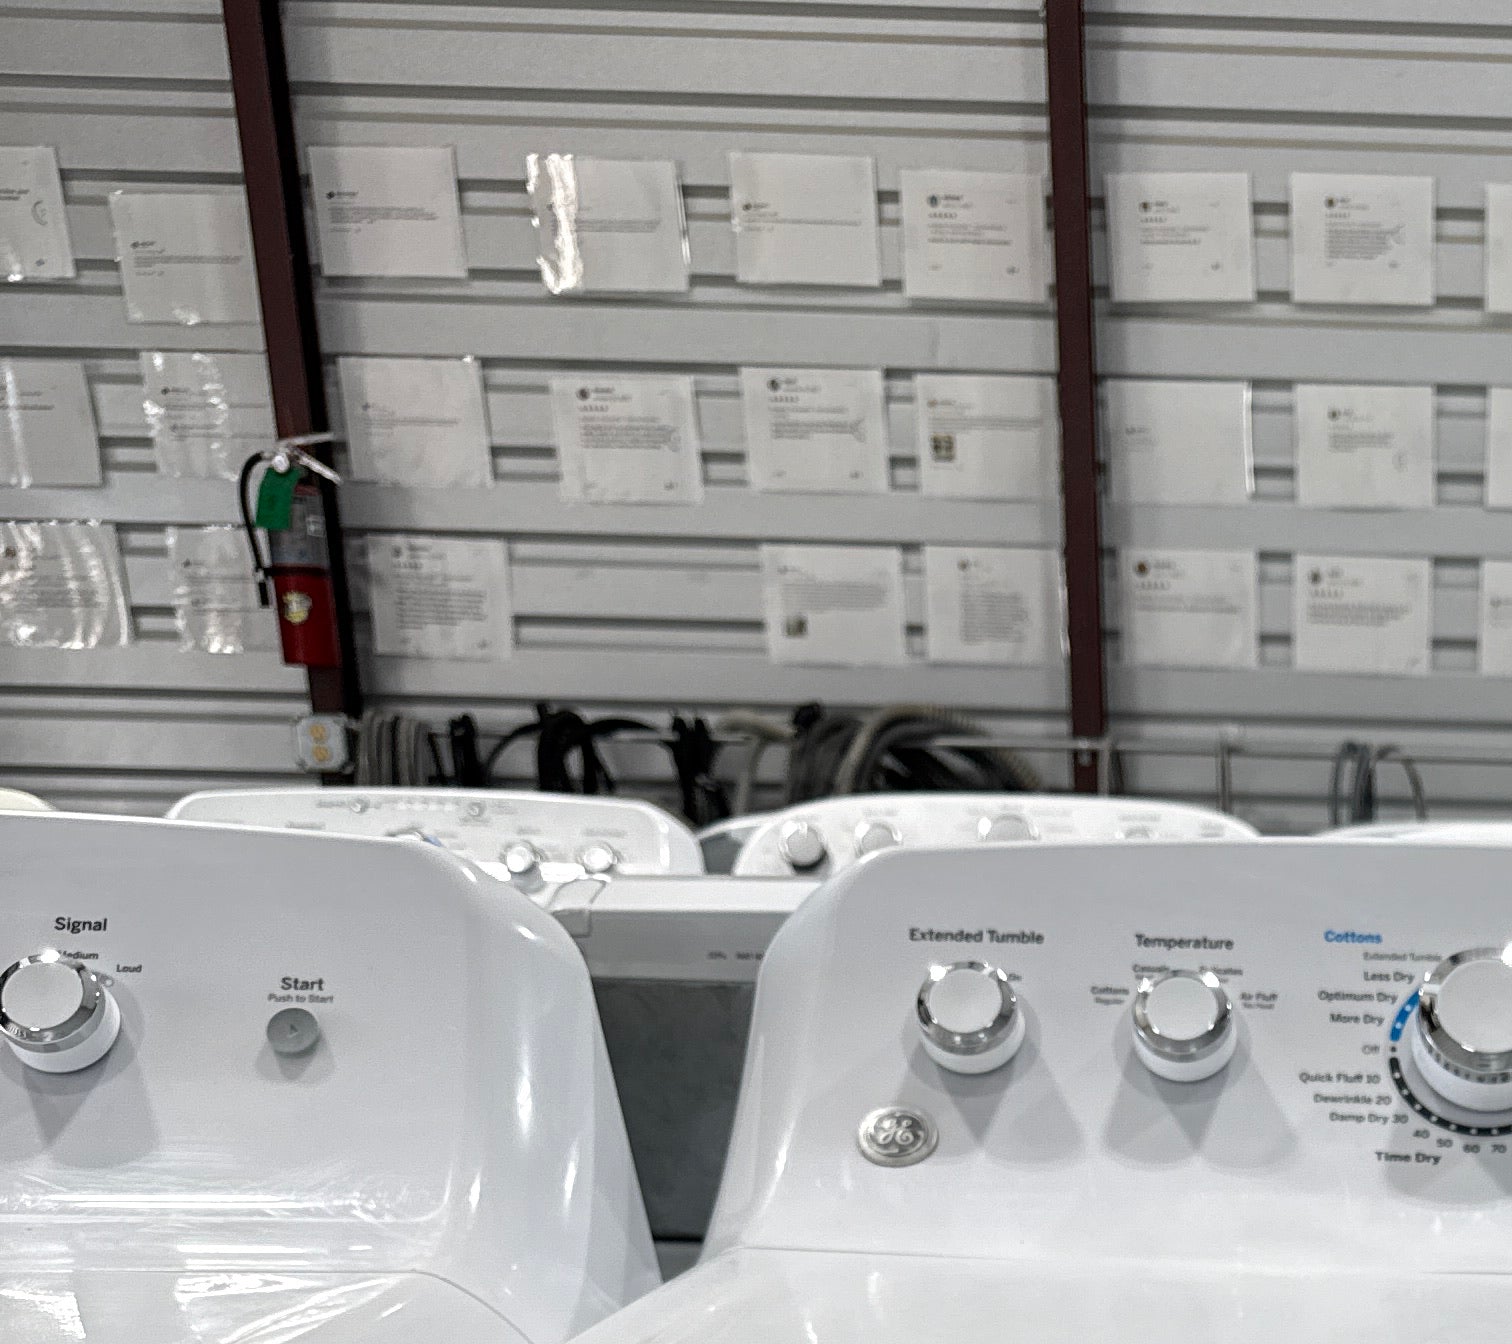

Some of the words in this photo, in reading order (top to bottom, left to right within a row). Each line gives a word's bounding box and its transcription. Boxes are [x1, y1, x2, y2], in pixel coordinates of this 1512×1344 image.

[54, 917, 108, 934] Signal
[909, 928, 983, 943] Extended
[986, 930, 1044, 944] Tumble
[1135, 933, 1235, 951] Temperature
[1324, 930, 1383, 944] Cottons
[58, 950, 99, 960] edium
[116, 964, 142, 973] Loud
[280, 976, 324, 991] Start
[1363, 971, 1391, 982] Less
[1393, 971, 1415, 984] Dry
[268, 993, 293, 1003] Push
[308, 994, 334, 1004] Start
[1317, 990, 1375, 1002] Optimum
[1376, 991, 1398, 1004] Dry
[1329, 1013, 1361, 1024] More
[1363, 1014, 1385, 1027] Dry
[1299, 1072, 1334, 1084] Quick
[1375, 1095, 1393, 1106] 20
[1329, 1111, 1366, 1124] Damp
[1367, 1113, 1390, 1126] Dry
[1391, 1113, 1409, 1125] 30
[1413, 1129, 1431, 1140] 40
[1436, 1138, 1454, 1149] 50
[1463, 1143, 1482, 1155] 60
[1490, 1143, 1508, 1154] 70
[1375, 1151, 1412, 1163] Time
[1414, 1152, 1442, 1166] Dry
